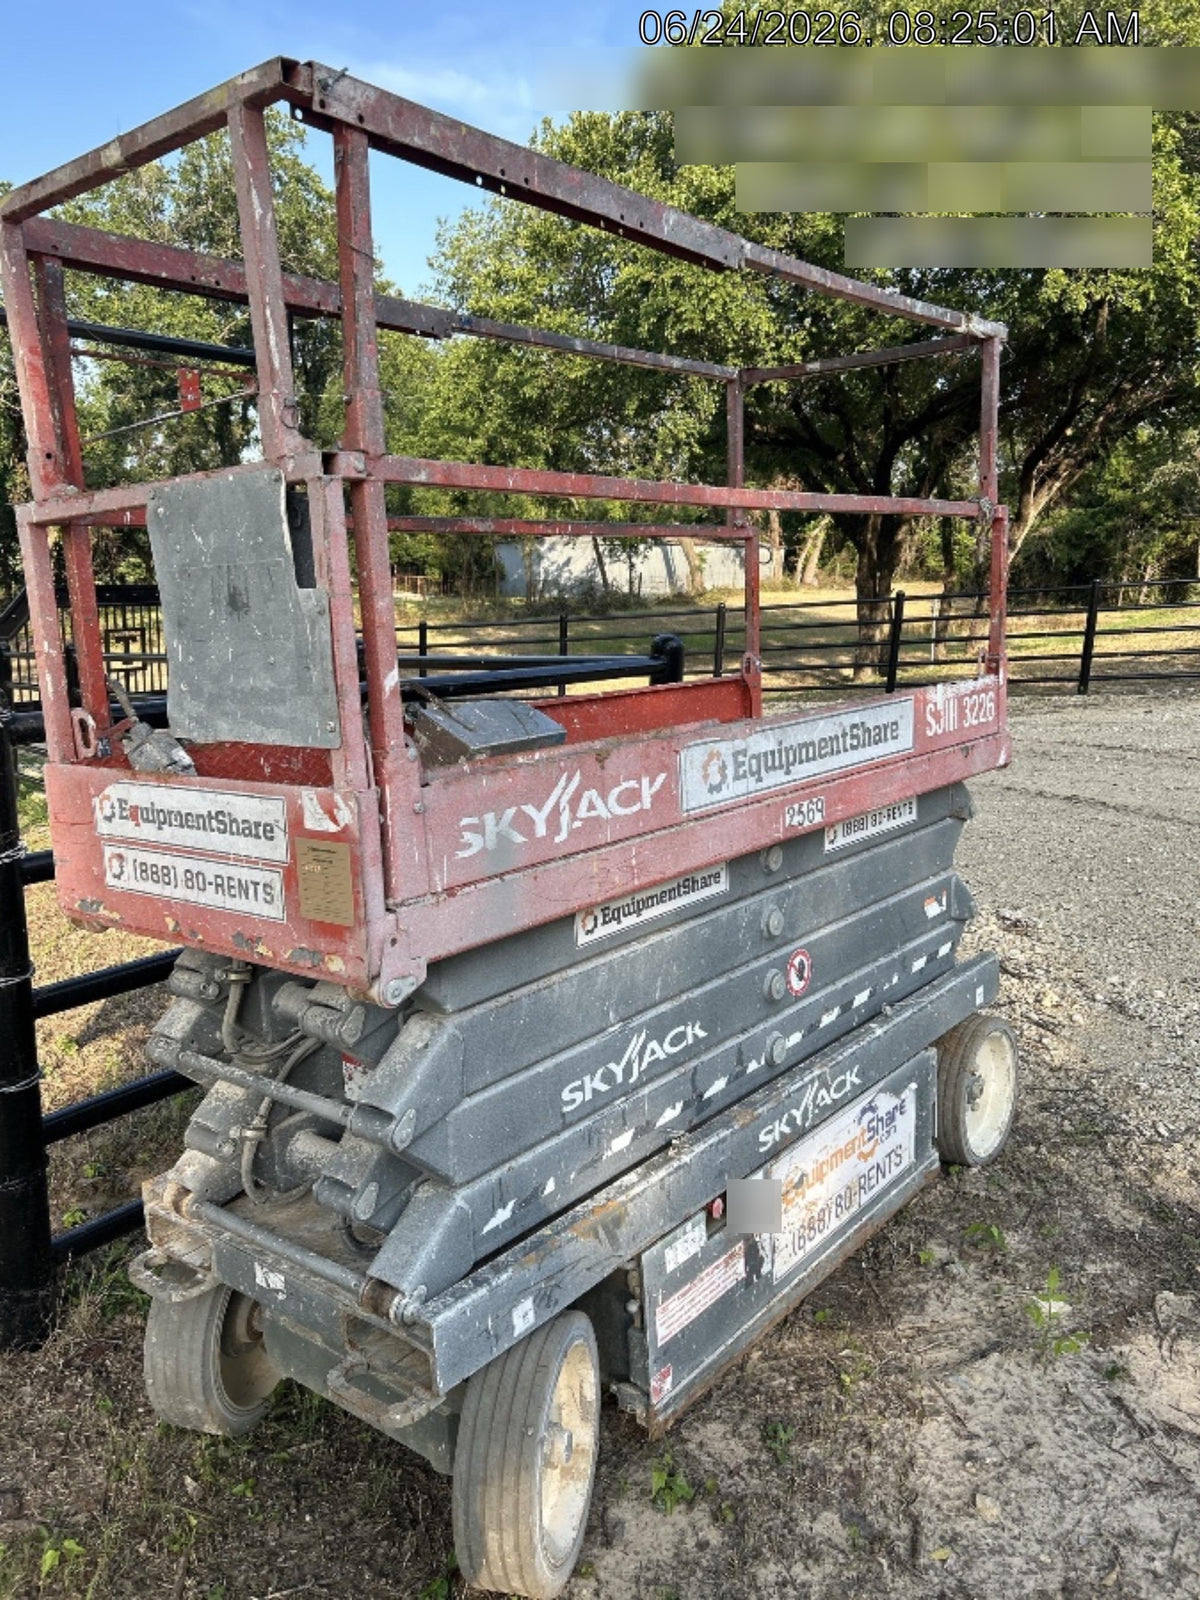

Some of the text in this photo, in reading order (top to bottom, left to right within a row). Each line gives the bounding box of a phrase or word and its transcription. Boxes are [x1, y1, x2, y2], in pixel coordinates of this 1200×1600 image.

[963, 691, 995, 727] 3226
[732, 720, 899, 783] EquipmentShare
[116, 797, 276, 842] EquipmentShare
[786, 799, 825, 827] 2569
[132, 857, 179, 888] (888)
[184, 868, 275, 905] 80-RENTS
[600, 870, 722, 928] EquipmentShare
[561, 1020, 708, 1113] SKYJACK
[758, 1064, 863, 1153] SKYJACK
[835, 1144, 903, 1220] 80-RENTS
